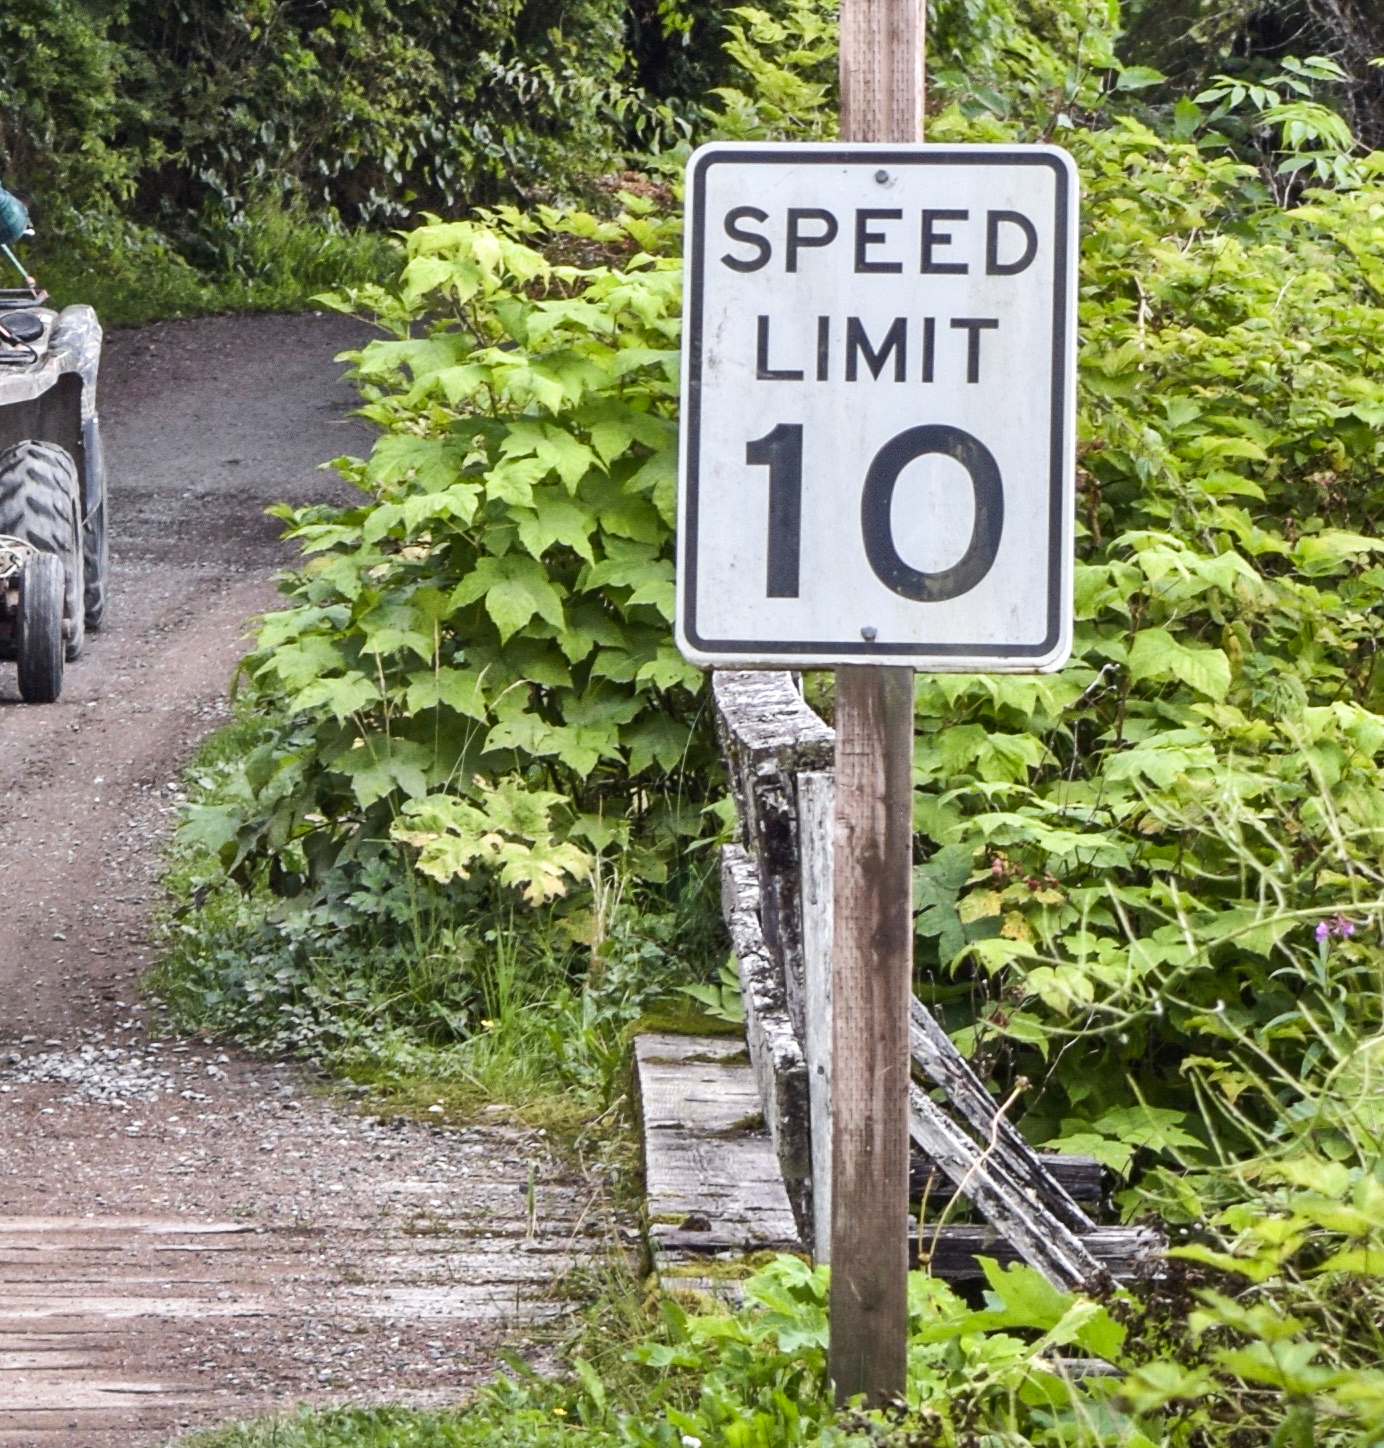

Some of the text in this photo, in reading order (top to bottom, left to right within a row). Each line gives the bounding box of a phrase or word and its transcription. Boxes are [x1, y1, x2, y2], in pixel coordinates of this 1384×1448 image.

[720, 206, 1038, 276] SPEED
[756, 314, 999, 384] LIMIT
[745, 423, 1005, 603] 10
